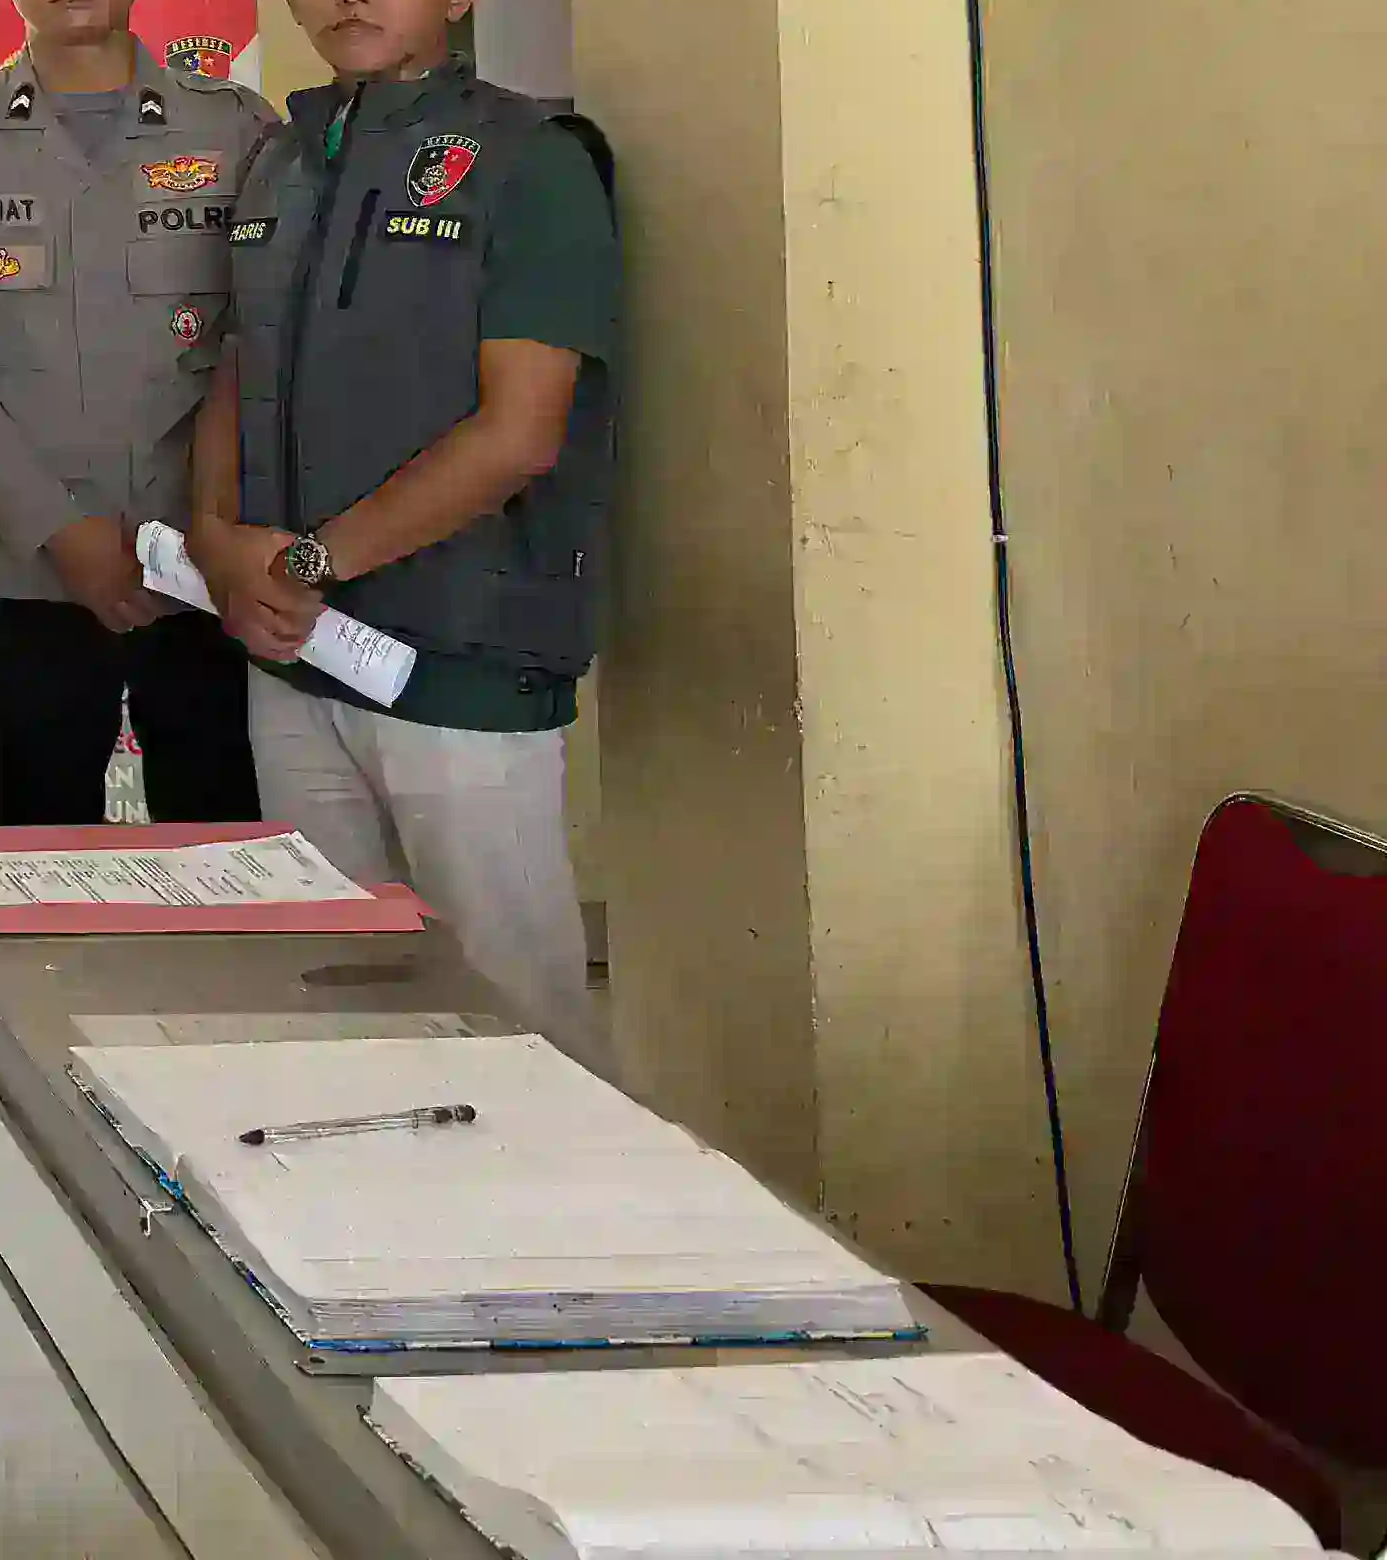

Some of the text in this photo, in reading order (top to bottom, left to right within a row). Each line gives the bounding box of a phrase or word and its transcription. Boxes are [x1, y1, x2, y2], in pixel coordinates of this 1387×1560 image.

[229, 222, 267, 241] HARIS
[387, 216, 462, 240] SUB III
